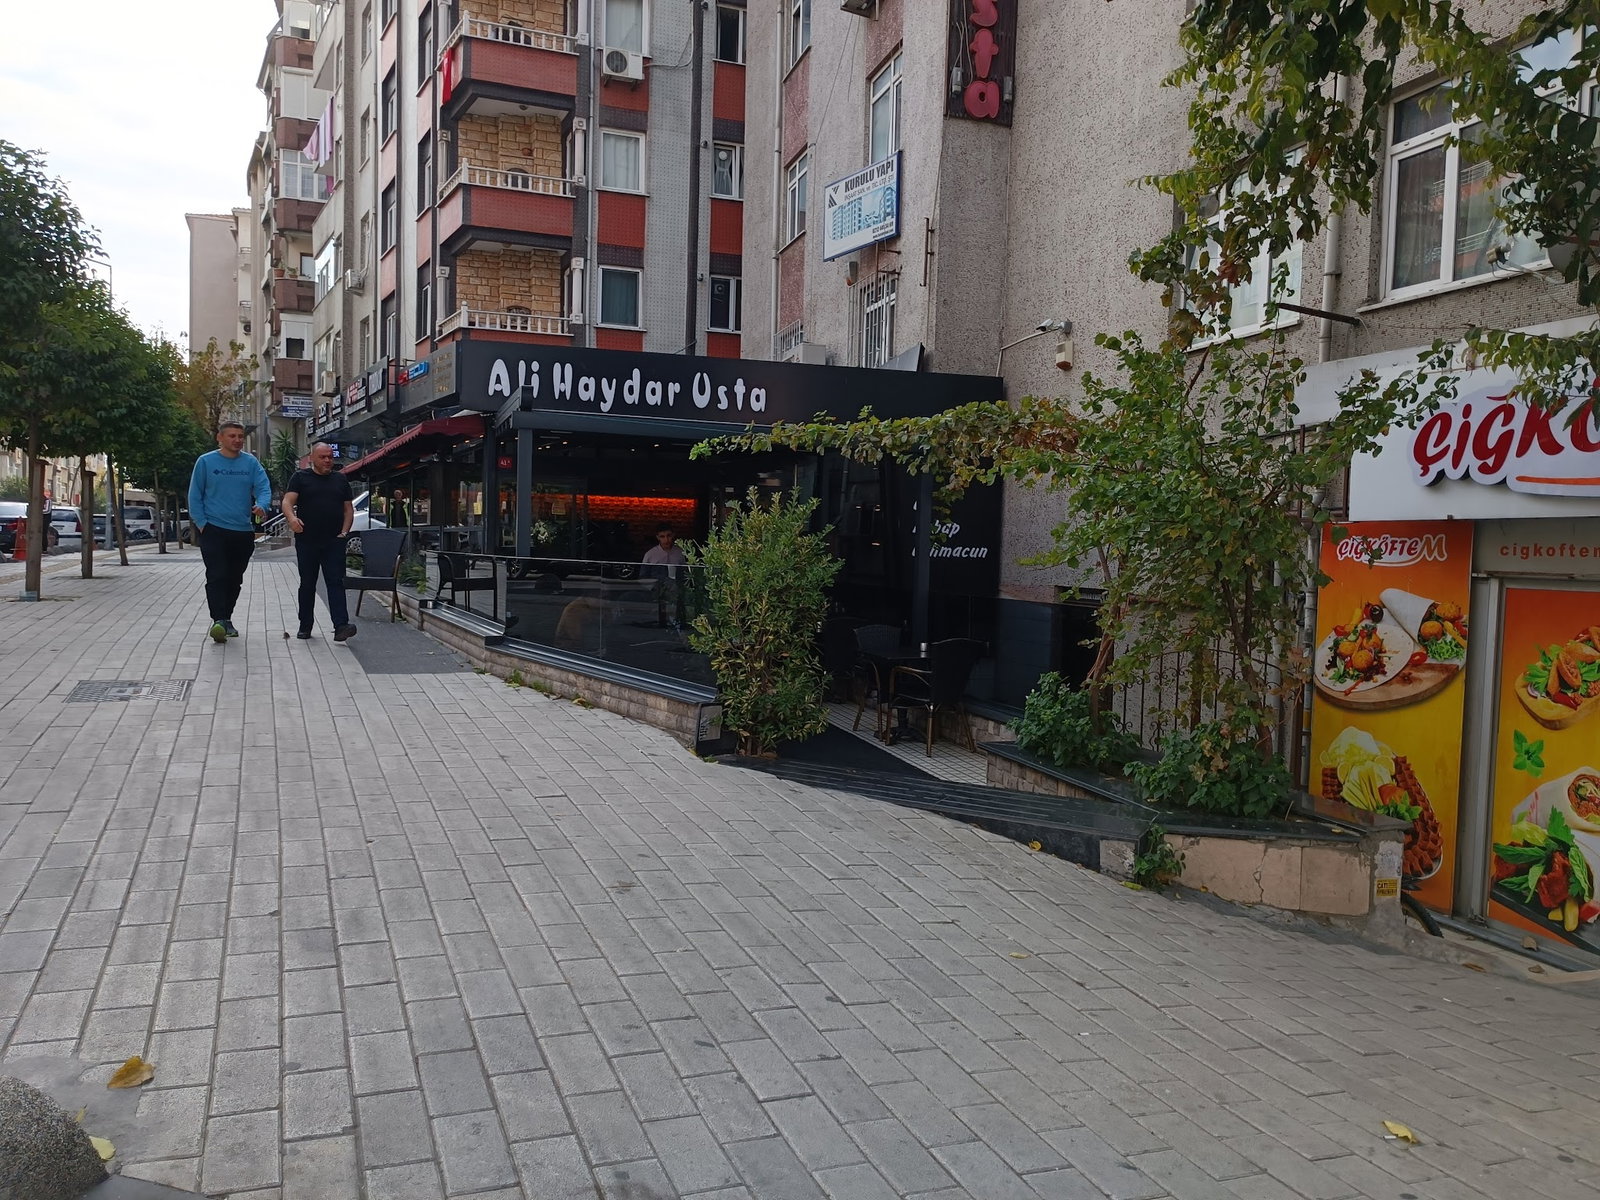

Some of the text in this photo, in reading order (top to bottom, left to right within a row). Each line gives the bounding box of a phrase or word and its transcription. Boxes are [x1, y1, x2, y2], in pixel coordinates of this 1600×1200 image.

[845, 160, 894, 193] KURULU YAPI
[488, 358, 767, 413] Ali Haydar Usta
